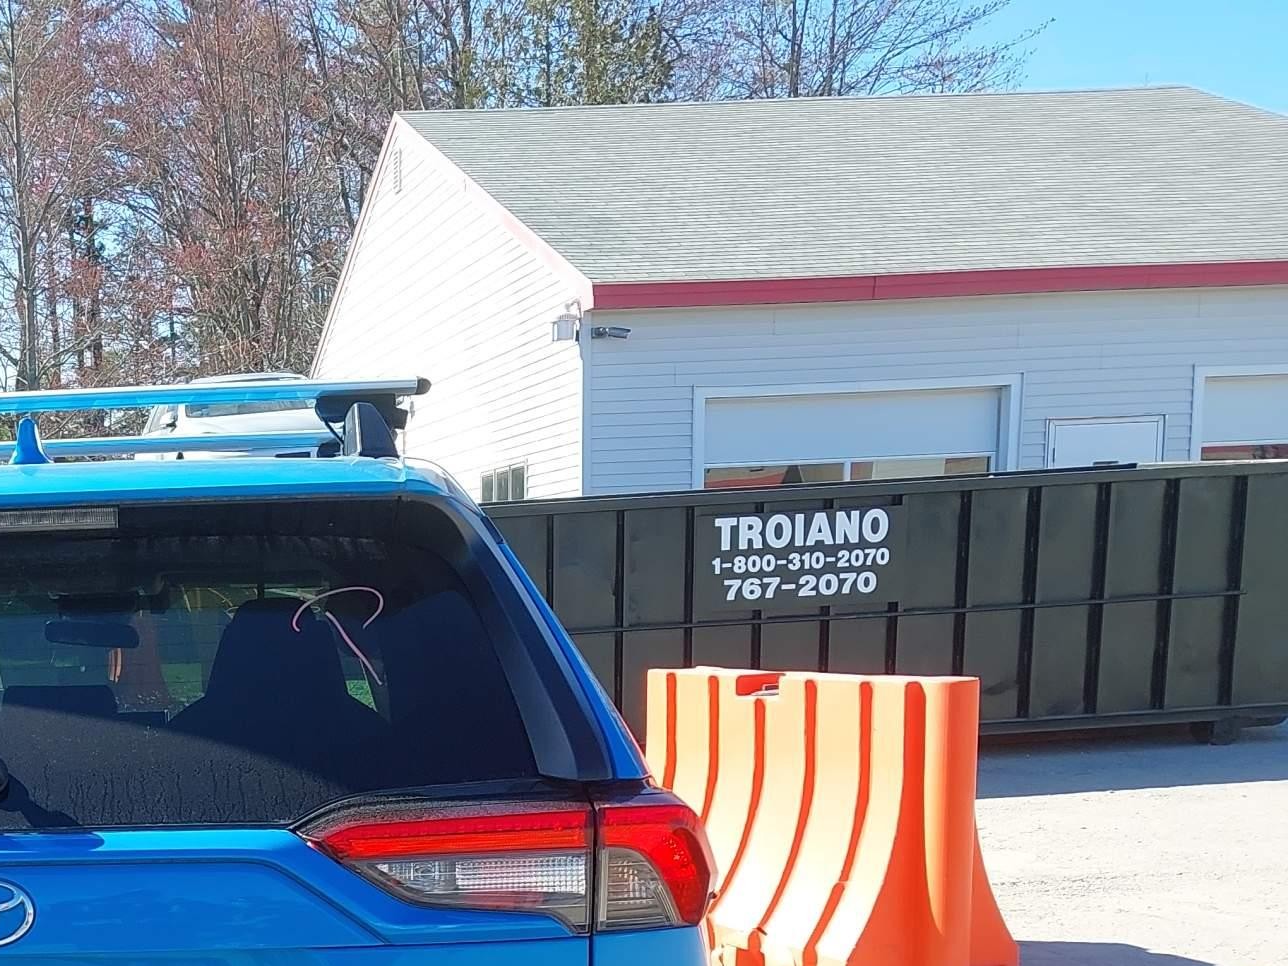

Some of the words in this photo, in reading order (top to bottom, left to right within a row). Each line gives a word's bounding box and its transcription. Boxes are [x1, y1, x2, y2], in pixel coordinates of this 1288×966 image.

[715, 508, 889, 551] TROIANO
[712, 547, 890, 575] 1-800-310-2070
[723, 571, 878, 601] 767-2070
